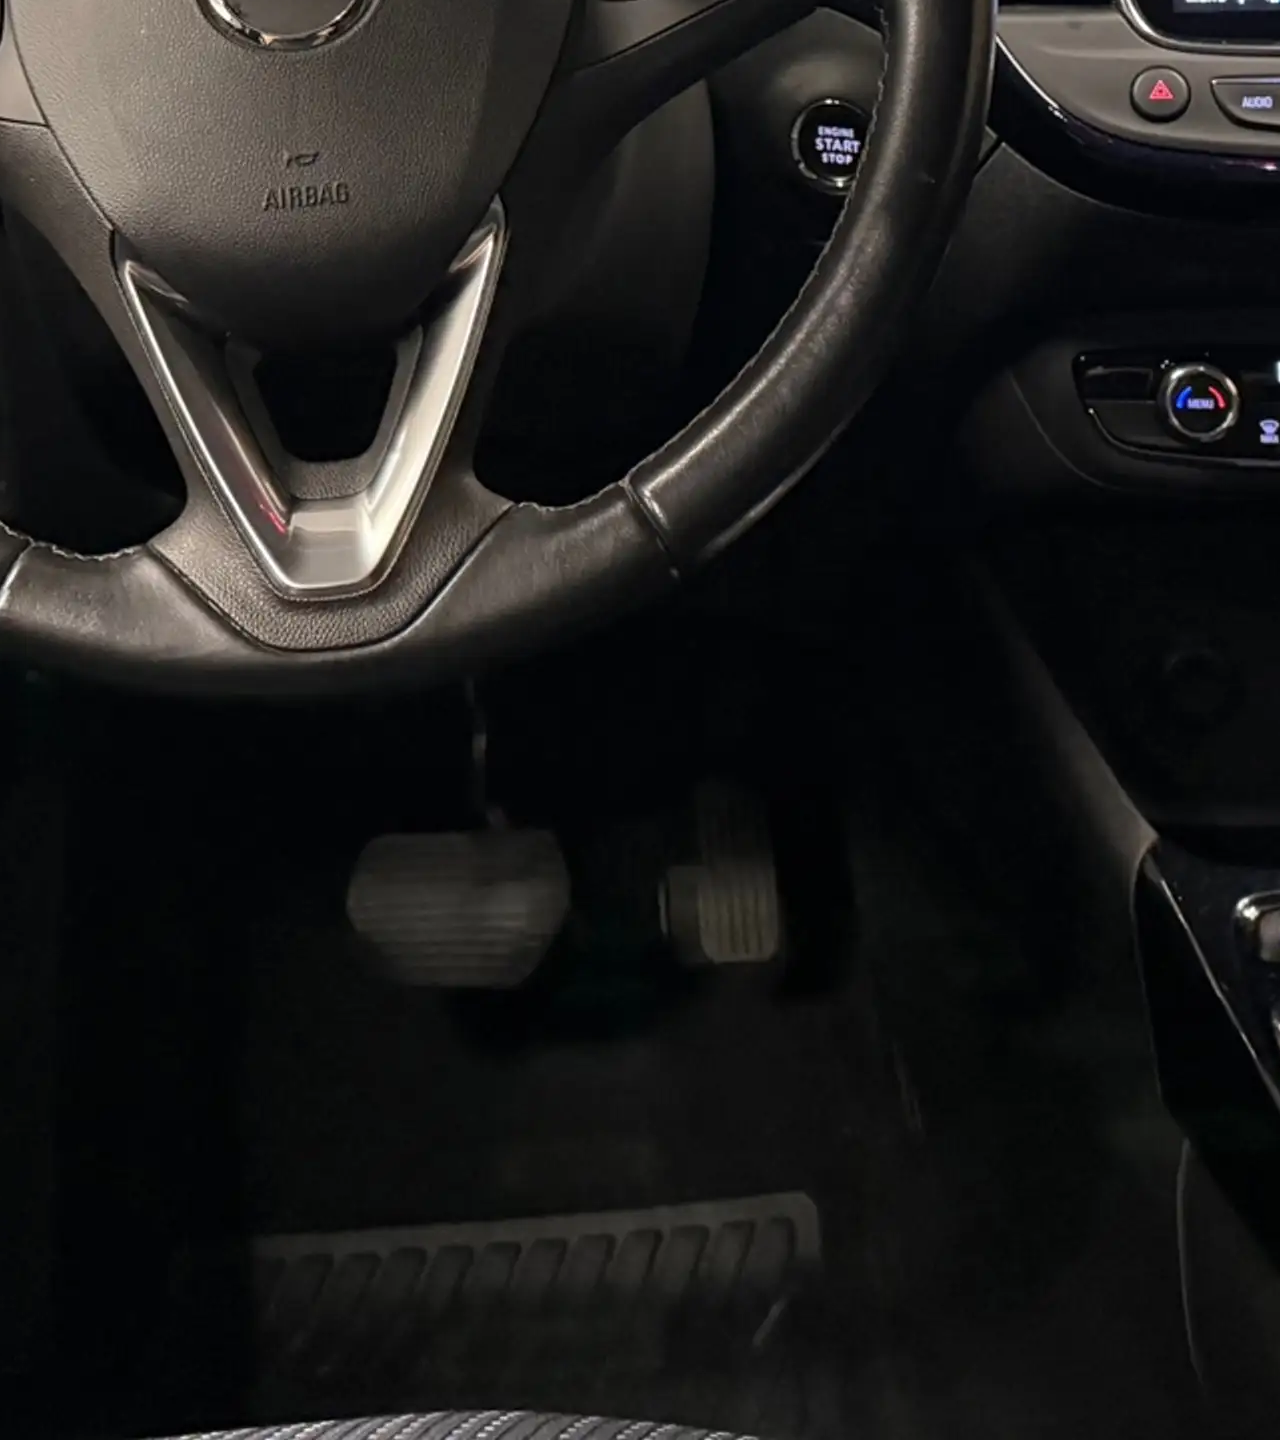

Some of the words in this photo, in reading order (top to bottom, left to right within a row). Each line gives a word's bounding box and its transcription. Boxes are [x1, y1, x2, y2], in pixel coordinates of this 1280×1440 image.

[1242, 96, 1273, 110] AUDIO
[817, 125, 854, 139] ENGINE
[814, 137, 861, 154] START
[821, 152, 853, 165] STOP
[264, 181, 350, 211] AIRBAG
